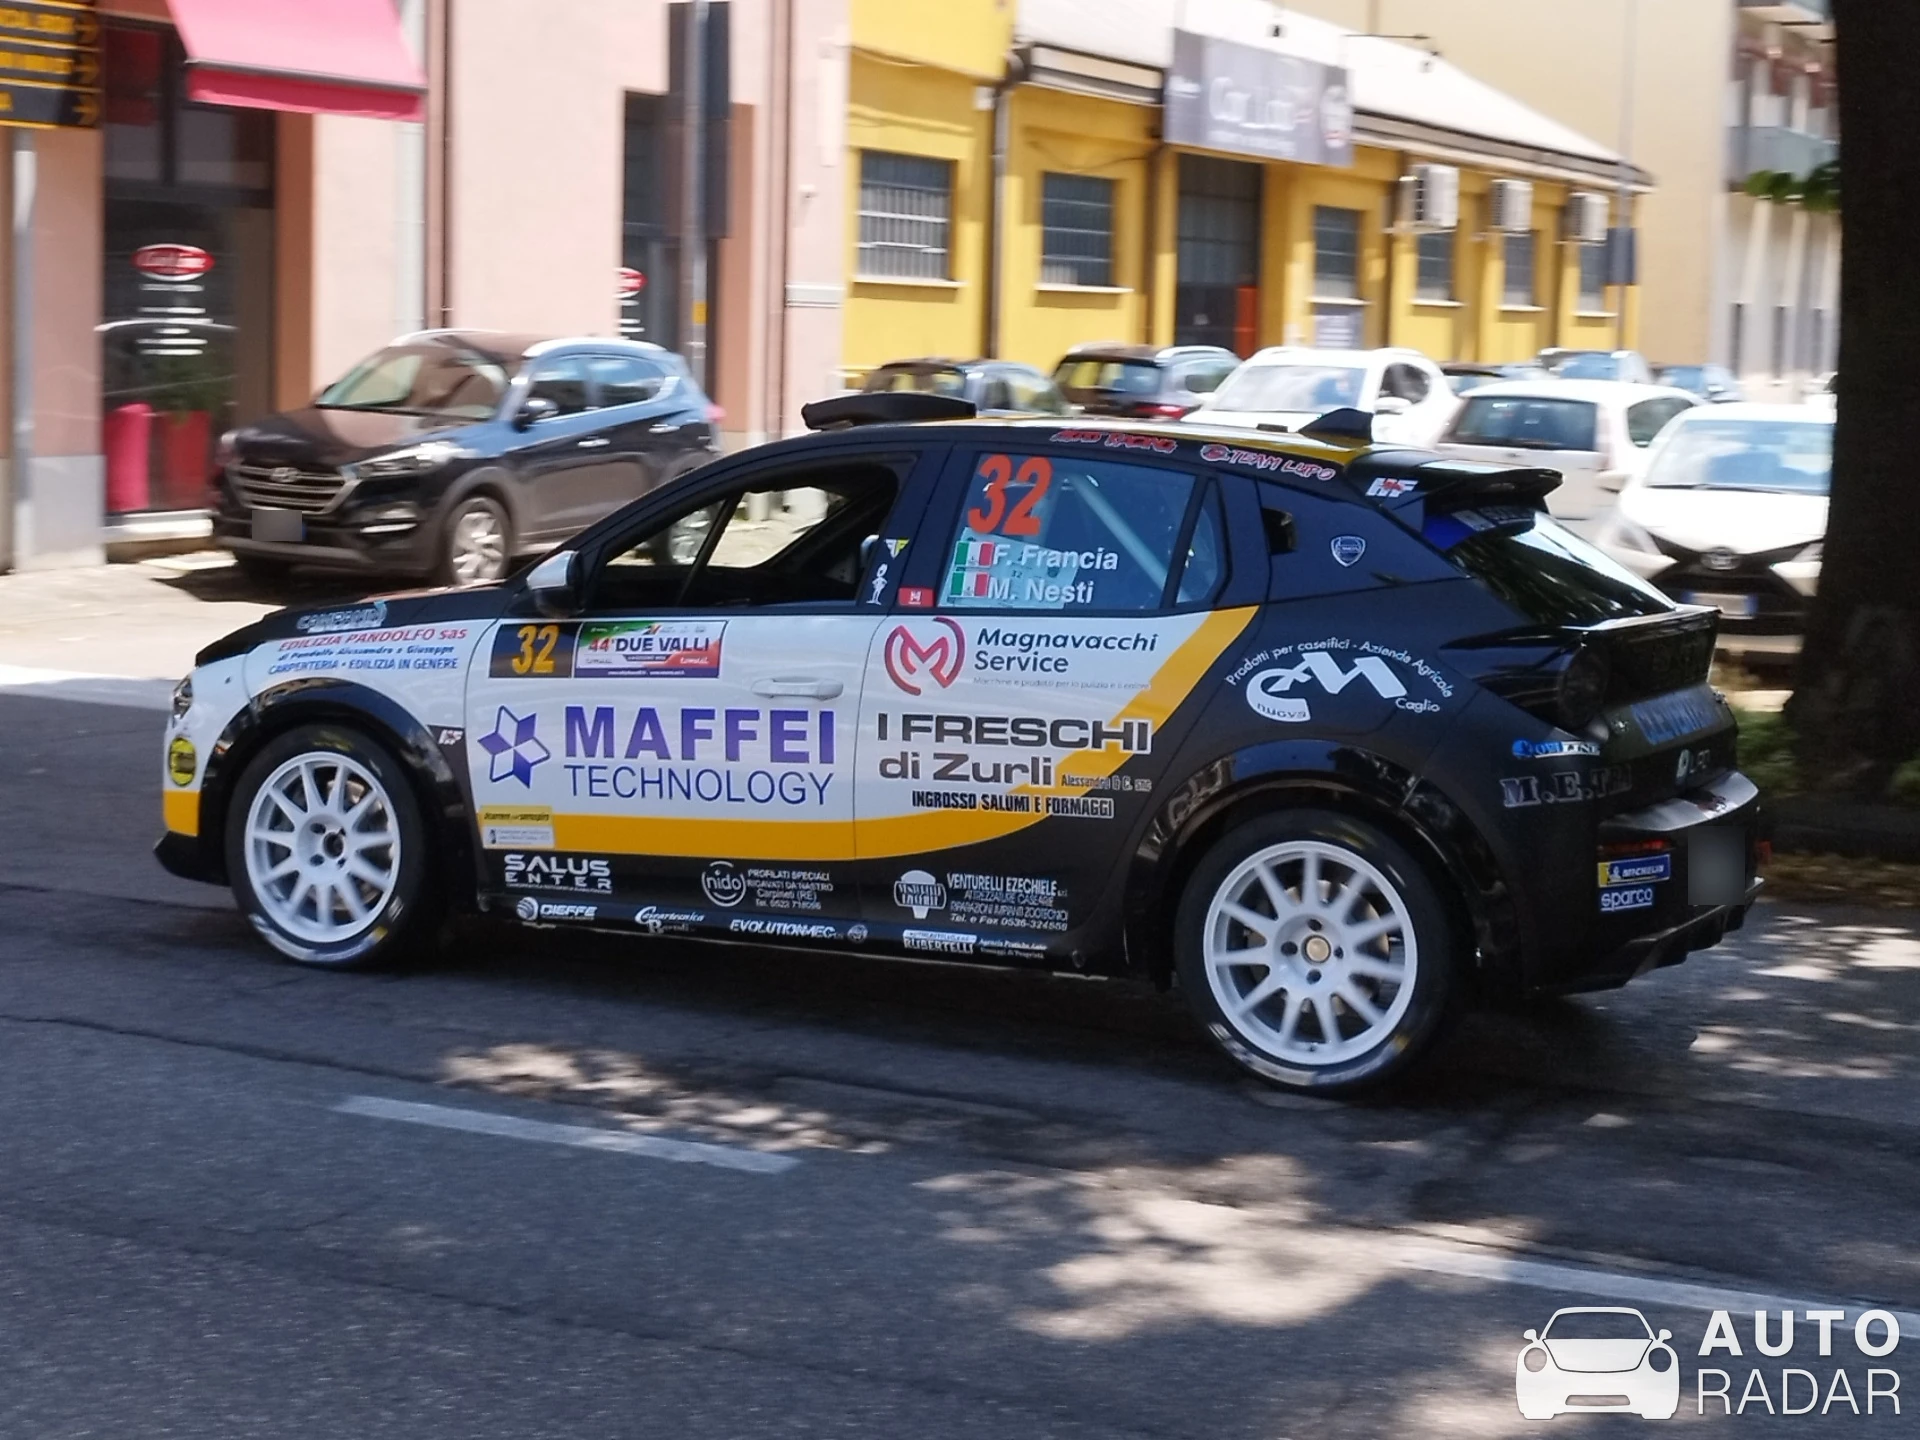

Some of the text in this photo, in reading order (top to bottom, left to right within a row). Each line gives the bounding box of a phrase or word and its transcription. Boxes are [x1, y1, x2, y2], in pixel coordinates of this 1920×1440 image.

[1230, 449, 1337, 481] TEAM LUPO
[967, 453, 1054, 536] 32
[993, 544, 1119, 571] F. Francia
[987, 577, 1095, 604] M. Nesti
[278, 628, 468, 652] EDILIZIA PANDOLFO sas
[511, 624, 560, 675] 32
[615, 637, 654, 652] DUE
[659, 637, 710, 652] VALLI
[976, 628, 1159, 653] Magnavacchi
[267, 657, 459, 675] CARPENTERIA EDILIZIA IN GENERE
[973, 650, 1069, 673] Service
[1224, 650, 1270, 686] Prodotti
[1272, 643, 1294, 660] per
[1297, 636, 1350, 651] caseifici
[1359, 640, 1413, 664] Azienda
[1411, 658, 1454, 699] Agricola
[1395, 697, 1441, 714] Caglio
[564, 705, 836, 765] MAFFEI
[877, 712, 1152, 753] I FRESCHI
[878, 752, 921, 780] di
[932, 753, 1053, 787] Zurli
[1060, 774, 1111, 790] Alessandro
[563, 764, 835, 806] TECHNOLOGY
[911, 790, 1114, 818] INGROSSO SALUMI E FORMAGGI
[504, 853, 611, 877] SALUS
[747, 868, 830, 882] PROFILATI SPECIALI
[1622, 864, 1665, 878] MICHELIN
[504, 871, 613, 890] ENTER
[706, 868, 742, 891] nido
[947, 872, 1004, 892] VENTURELLI
[1006, 876, 1057, 897] EZECHIELE
[797, 889, 817, 901] (RE)
[1600, 887, 1653, 911] sparco
[540, 904, 598, 917] DIEFFE
[950, 913, 968, 924] Tel.
[979, 916, 999, 926] Fax
[729, 918, 836, 939] EVOLUTIONMEC
[903, 937, 975, 955] RUBERTELLI
